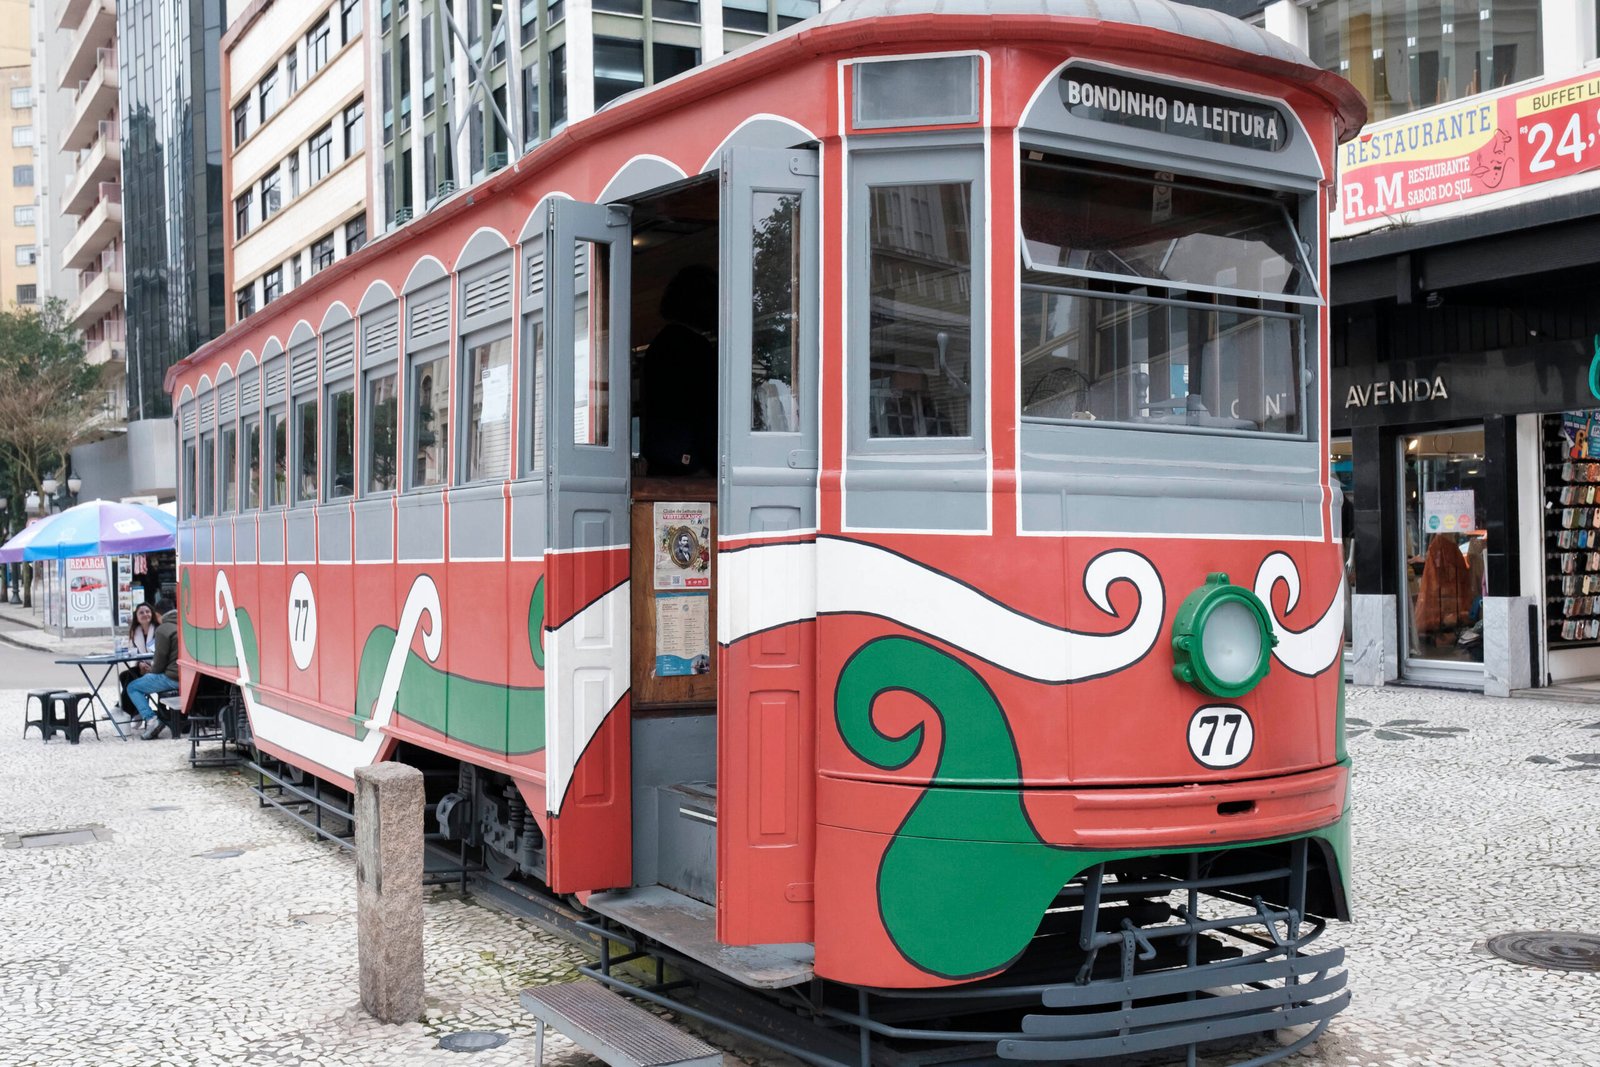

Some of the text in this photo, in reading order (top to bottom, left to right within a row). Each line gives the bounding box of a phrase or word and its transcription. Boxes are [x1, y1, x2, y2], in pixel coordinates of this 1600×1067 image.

[1067, 80, 1278, 140] BONDINHO DA LEITURA
[1533, 85, 1584, 110] BUFFET
[1346, 106, 1491, 166] RESTAURANTE
[1528, 107, 1600, 173] 24,
[1408, 156, 1471, 184] RESTAURANTE
[1344, 171, 1405, 220] R.M
[1408, 178, 1473, 206] SABOR DO SUL
[1345, 376, 1449, 409] AVENIDA
[70, 557, 105, 569] RECARGA
[73, 614, 95, 622] urbs
[294, 599, 309, 642] 77
[1199, 714, 1242, 757] 77
